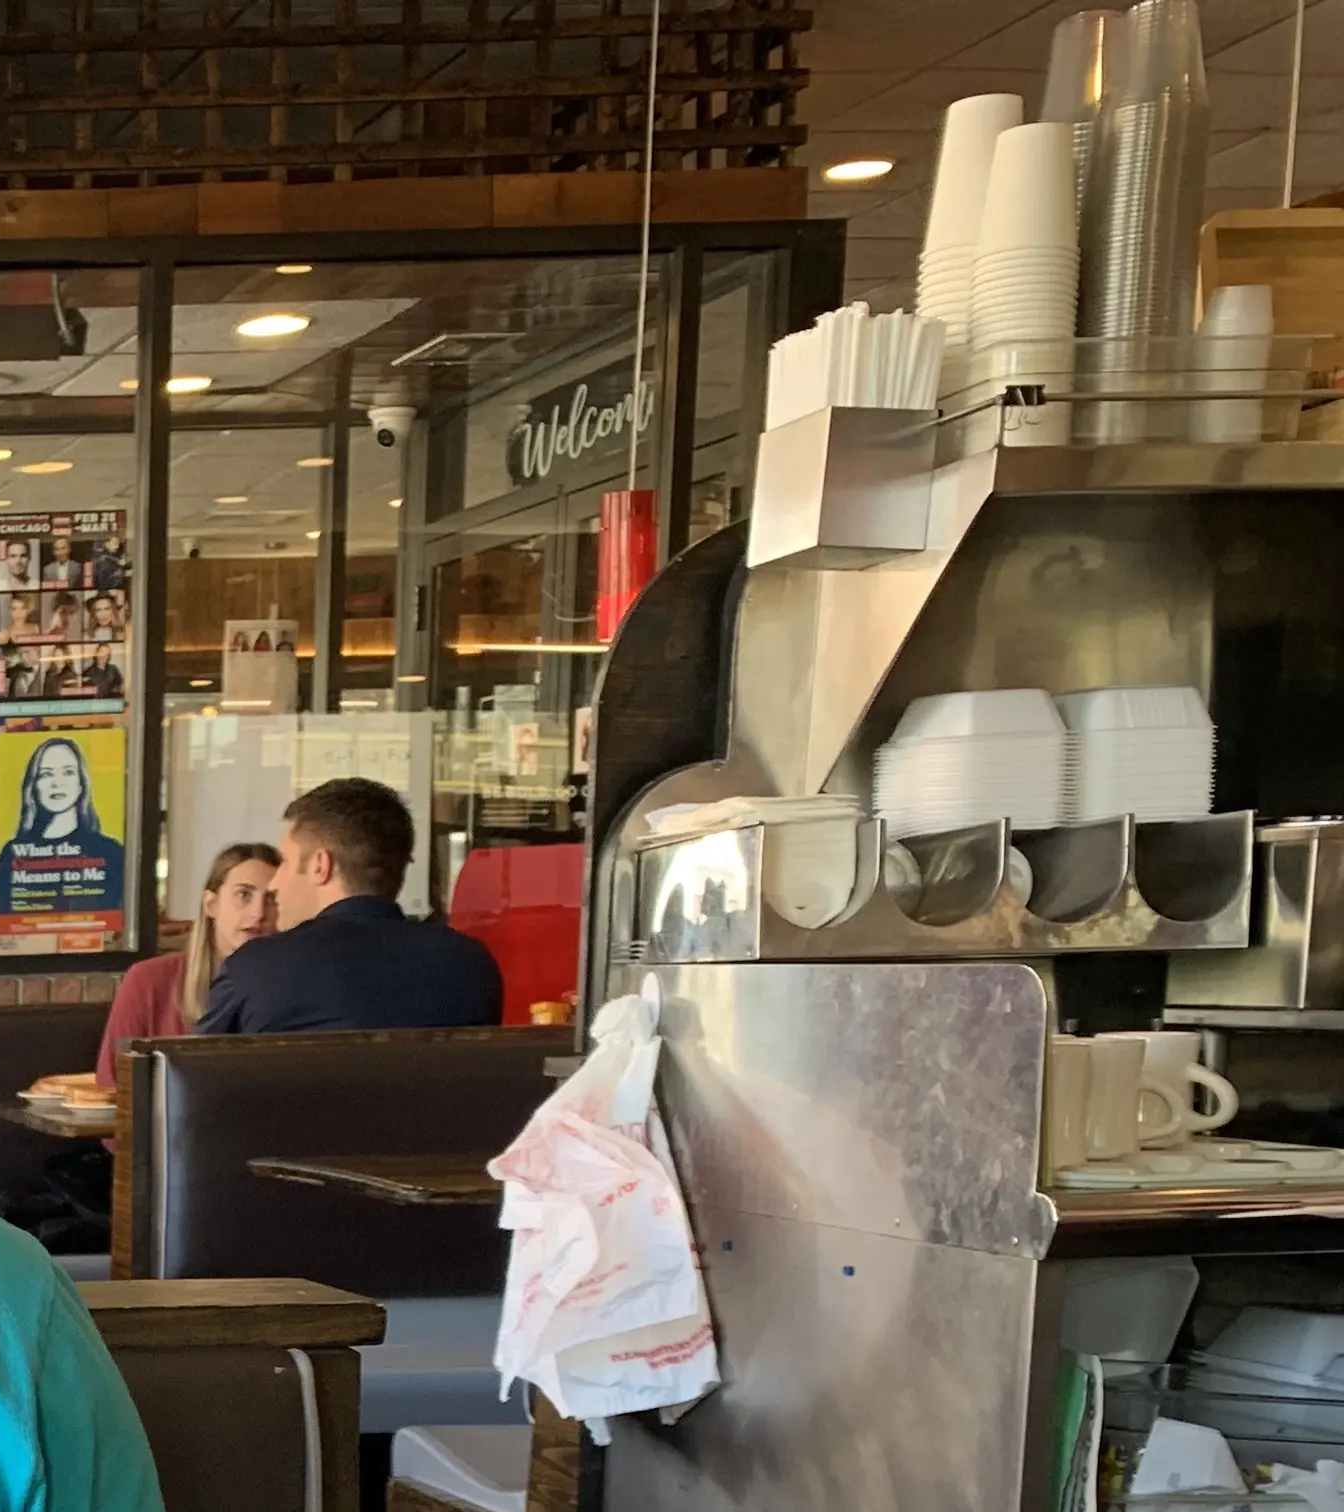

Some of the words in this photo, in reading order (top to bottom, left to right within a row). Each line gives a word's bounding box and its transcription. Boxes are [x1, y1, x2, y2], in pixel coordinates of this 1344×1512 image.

[515, 381, 654, 478] Welcome
[74, 513, 98, 523] FEB
[0, 523, 50, 535] CHICAGO
[13, 844, 53, 857] What
[56, 842, 81, 855] the
[12, 869, 61, 884] Means
[63, 870, 81, 881] to
[83, 867, 106, 880] Me
